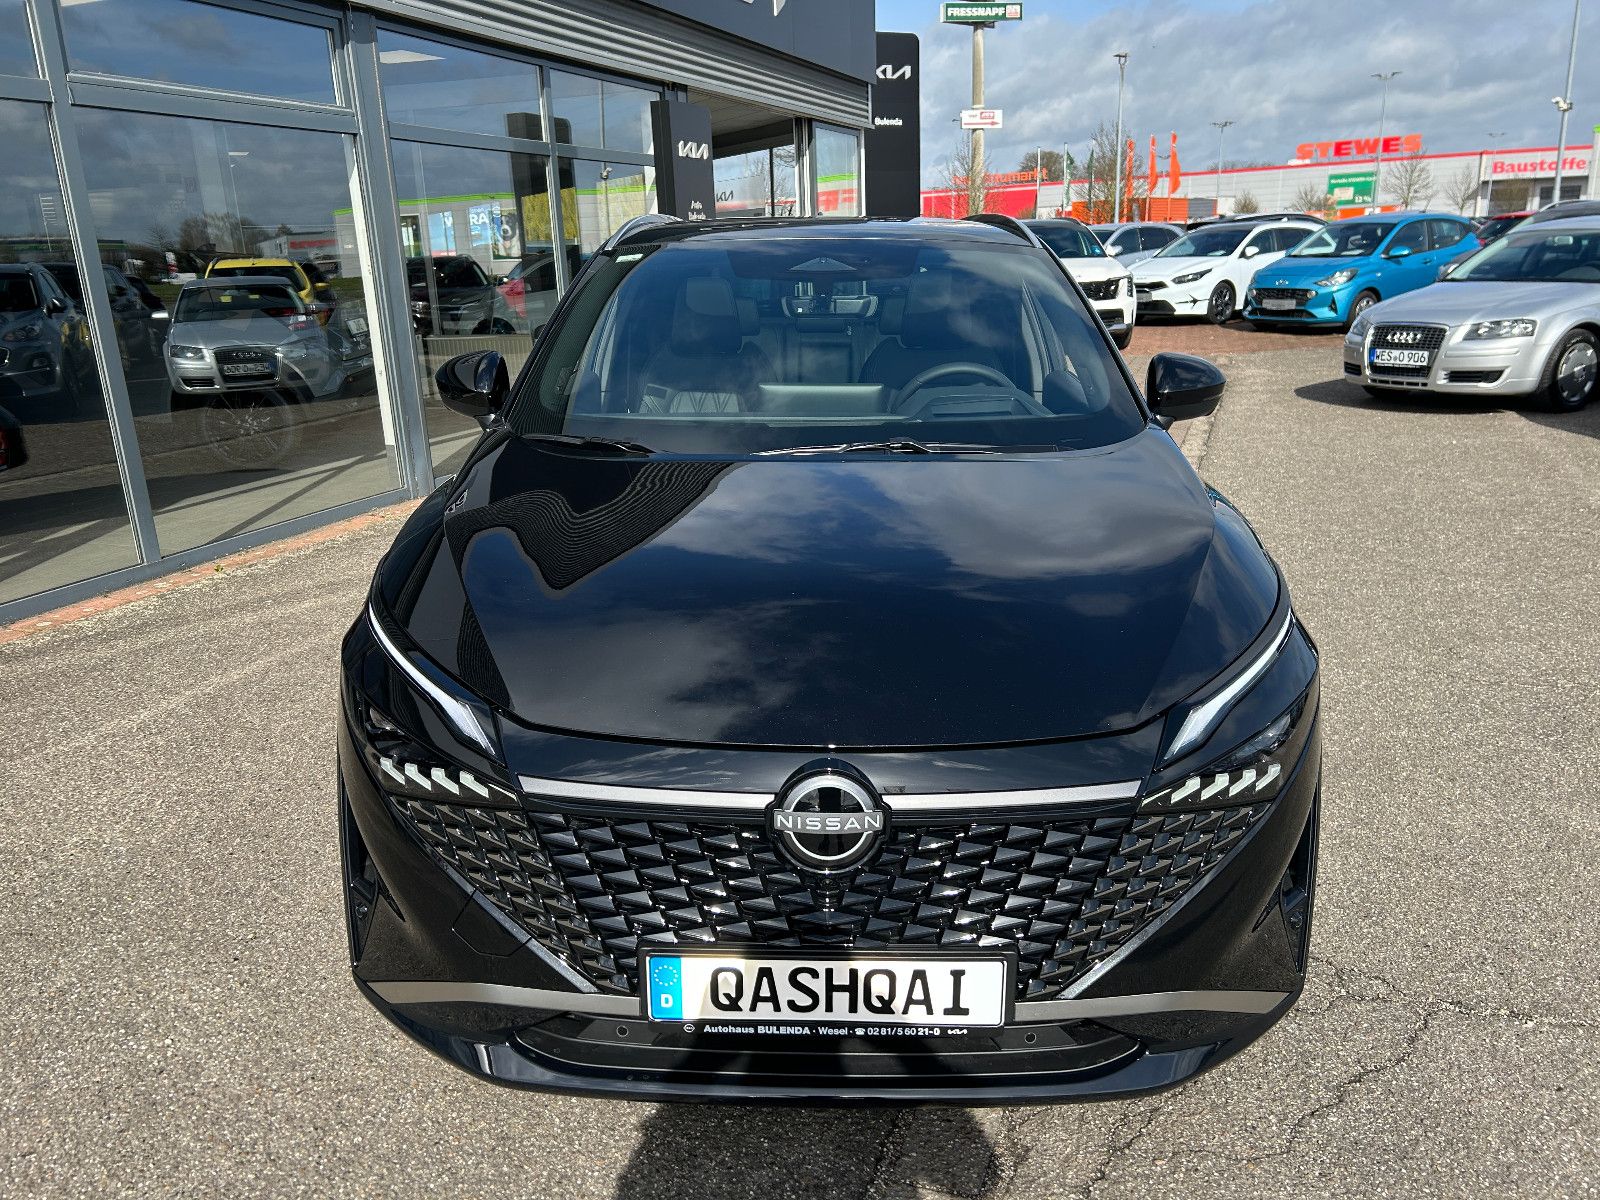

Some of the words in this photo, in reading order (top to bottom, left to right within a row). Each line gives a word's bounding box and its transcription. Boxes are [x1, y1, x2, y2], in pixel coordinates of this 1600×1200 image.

[947, 7, 1005, 16] FRESSNAPF
[679, 141, 709, 160] KIA
[1296, 134, 1422, 160] STEWES
[1492, 158, 1587, 174] Baustoffe
[1408, 353, 1426, 363] 906
[777, 815, 880, 831] NISSAN
[710, 966, 970, 1016] QASHQAI
[661, 994, 674, 1008] D
[703, 1025, 755, 1034] Autohaus
[757, 1025, 811, 1035] BULENDA
[817, 1026, 848, 1035] Wesel
